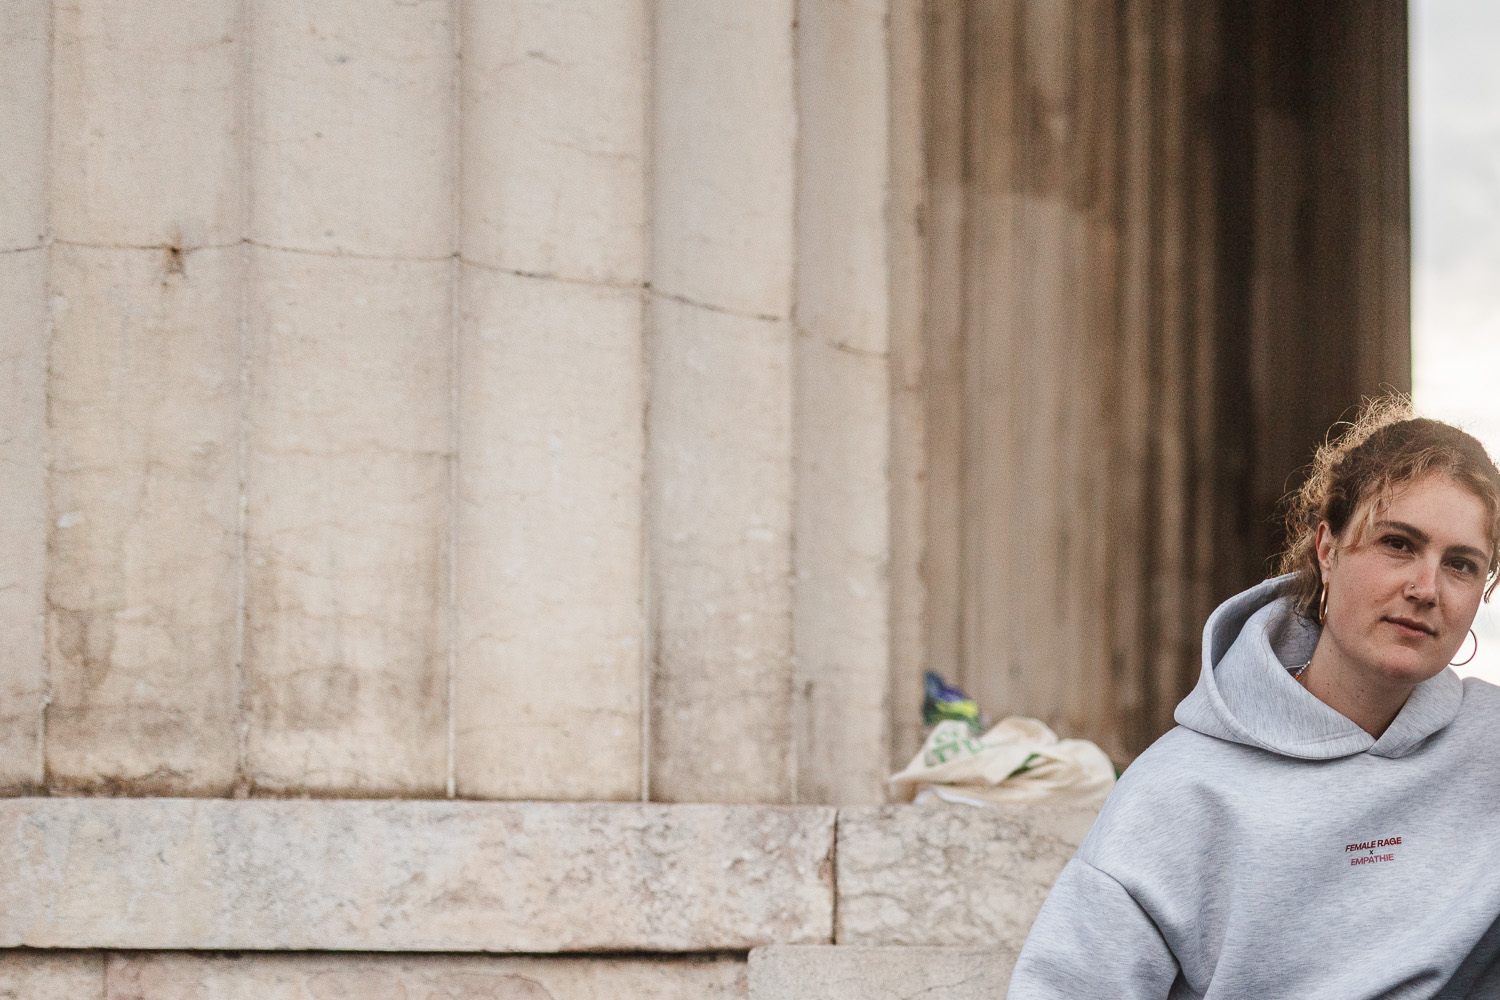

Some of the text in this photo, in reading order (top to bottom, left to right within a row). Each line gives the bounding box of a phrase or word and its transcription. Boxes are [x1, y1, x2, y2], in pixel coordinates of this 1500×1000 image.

[1345, 837, 1402, 852] FEMALE RAGE
[1350, 854, 1395, 866] EMPATHIE
